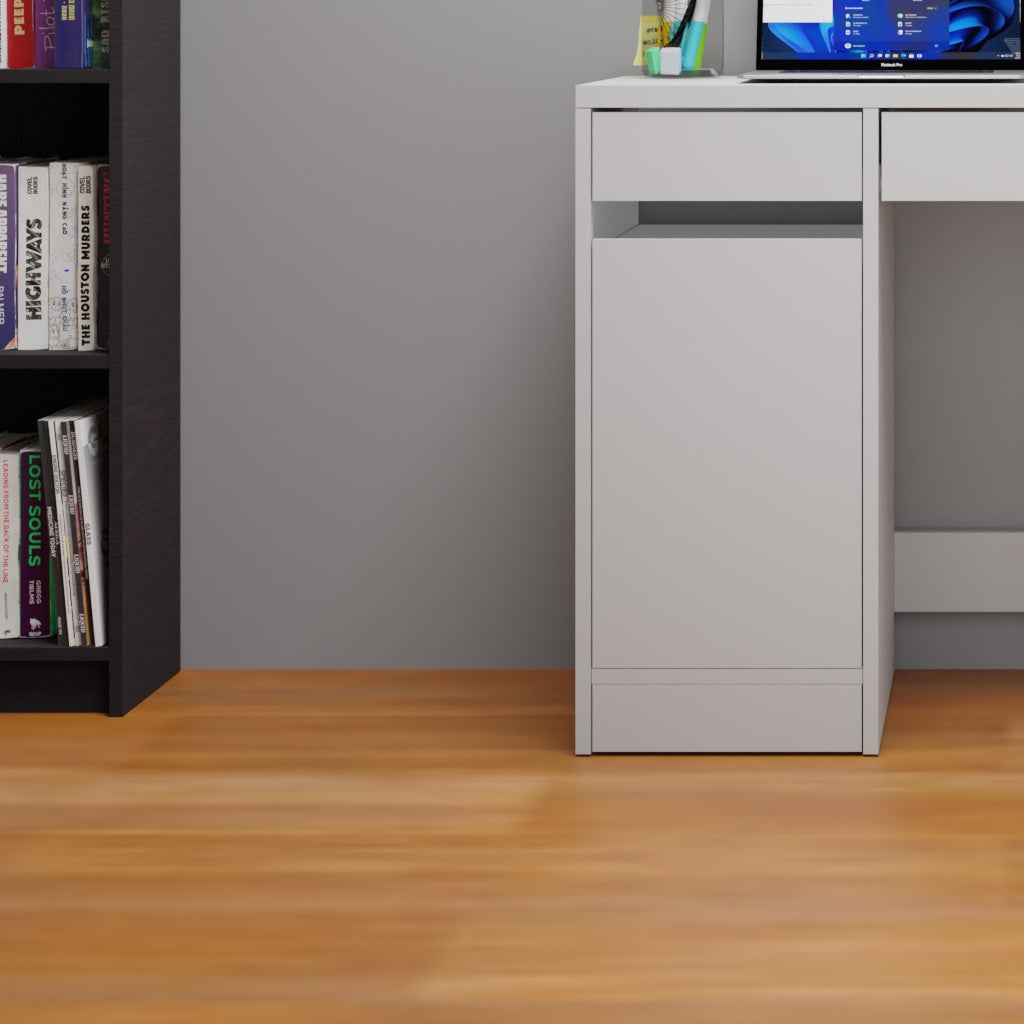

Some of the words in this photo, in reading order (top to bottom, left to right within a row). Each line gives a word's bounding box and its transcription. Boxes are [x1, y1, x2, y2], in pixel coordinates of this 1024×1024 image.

[81, 205, 90, 260] MURDERS
[26, 218, 43, 321] HIGHWAYS
[81, 264, 90, 321] HOUSTON
[82, 323, 90, 346] THE
[28, 454, 42, 501] LOST
[28, 506, 42, 567] SOULS
[46, 505, 54, 536] MEDICINE
